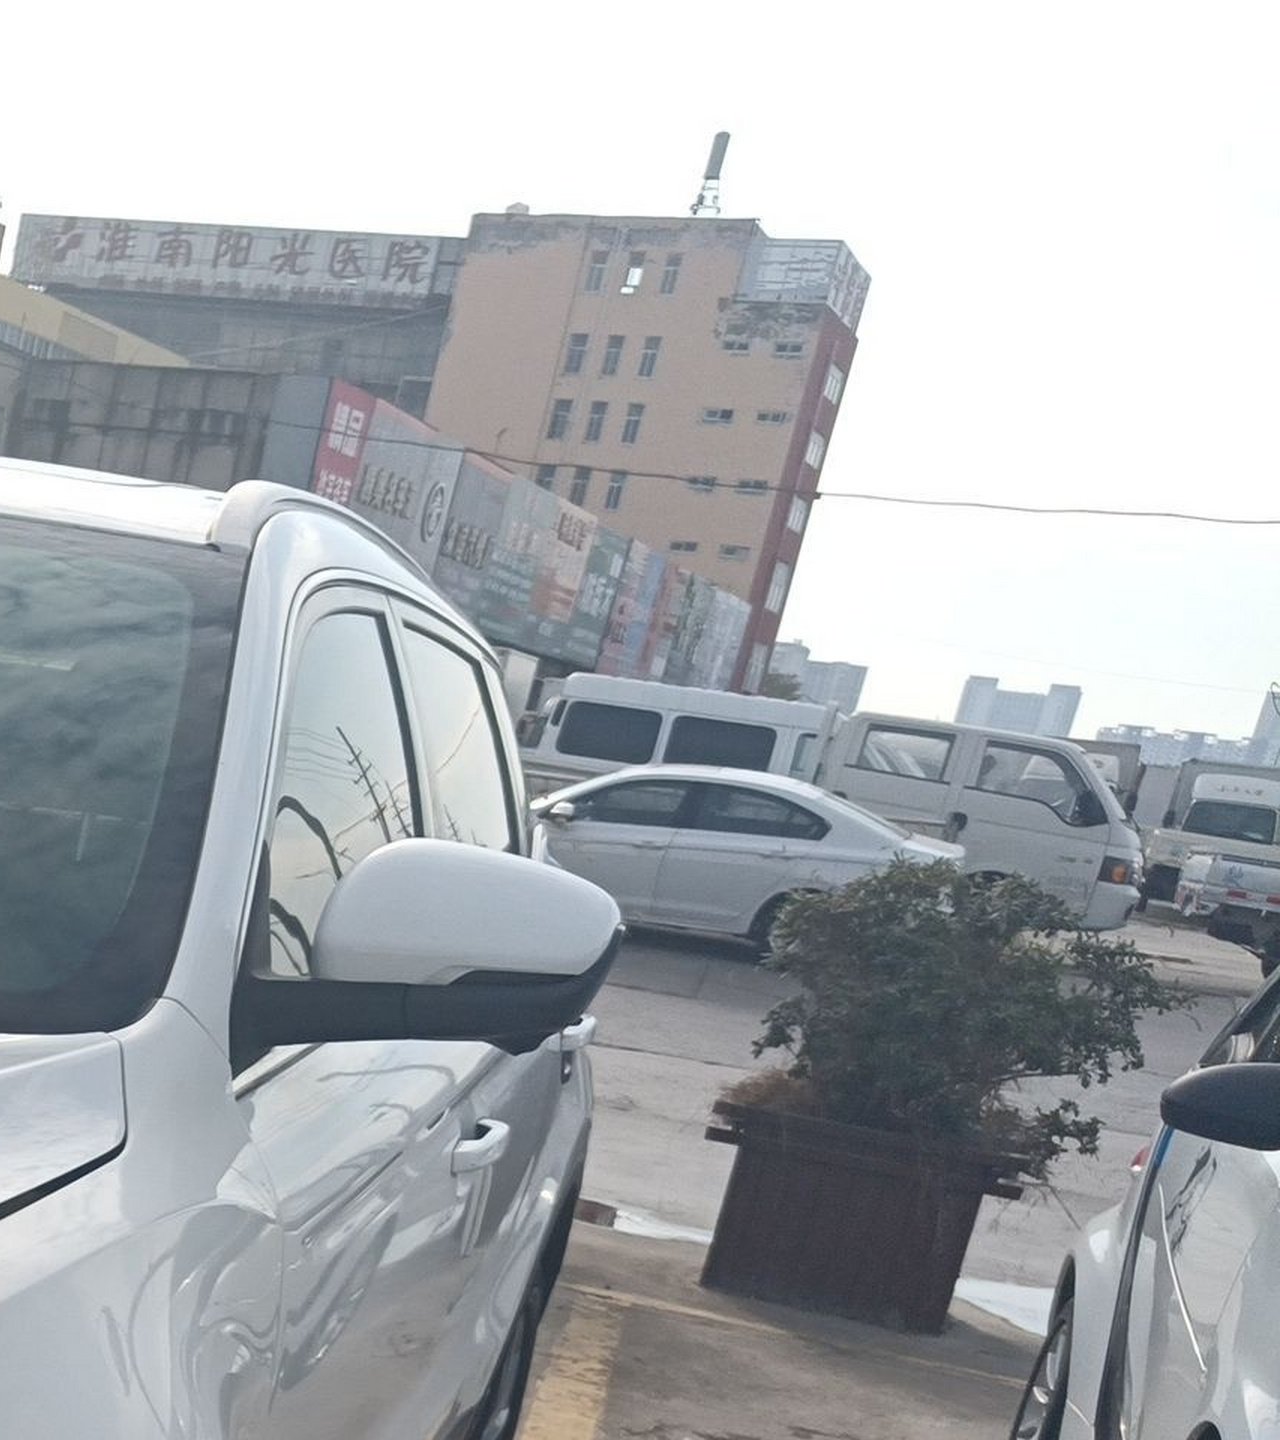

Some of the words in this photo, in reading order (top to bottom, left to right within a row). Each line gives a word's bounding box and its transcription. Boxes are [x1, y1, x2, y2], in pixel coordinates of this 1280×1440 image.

[95, 220, 432, 286] 淮南阳光医院
